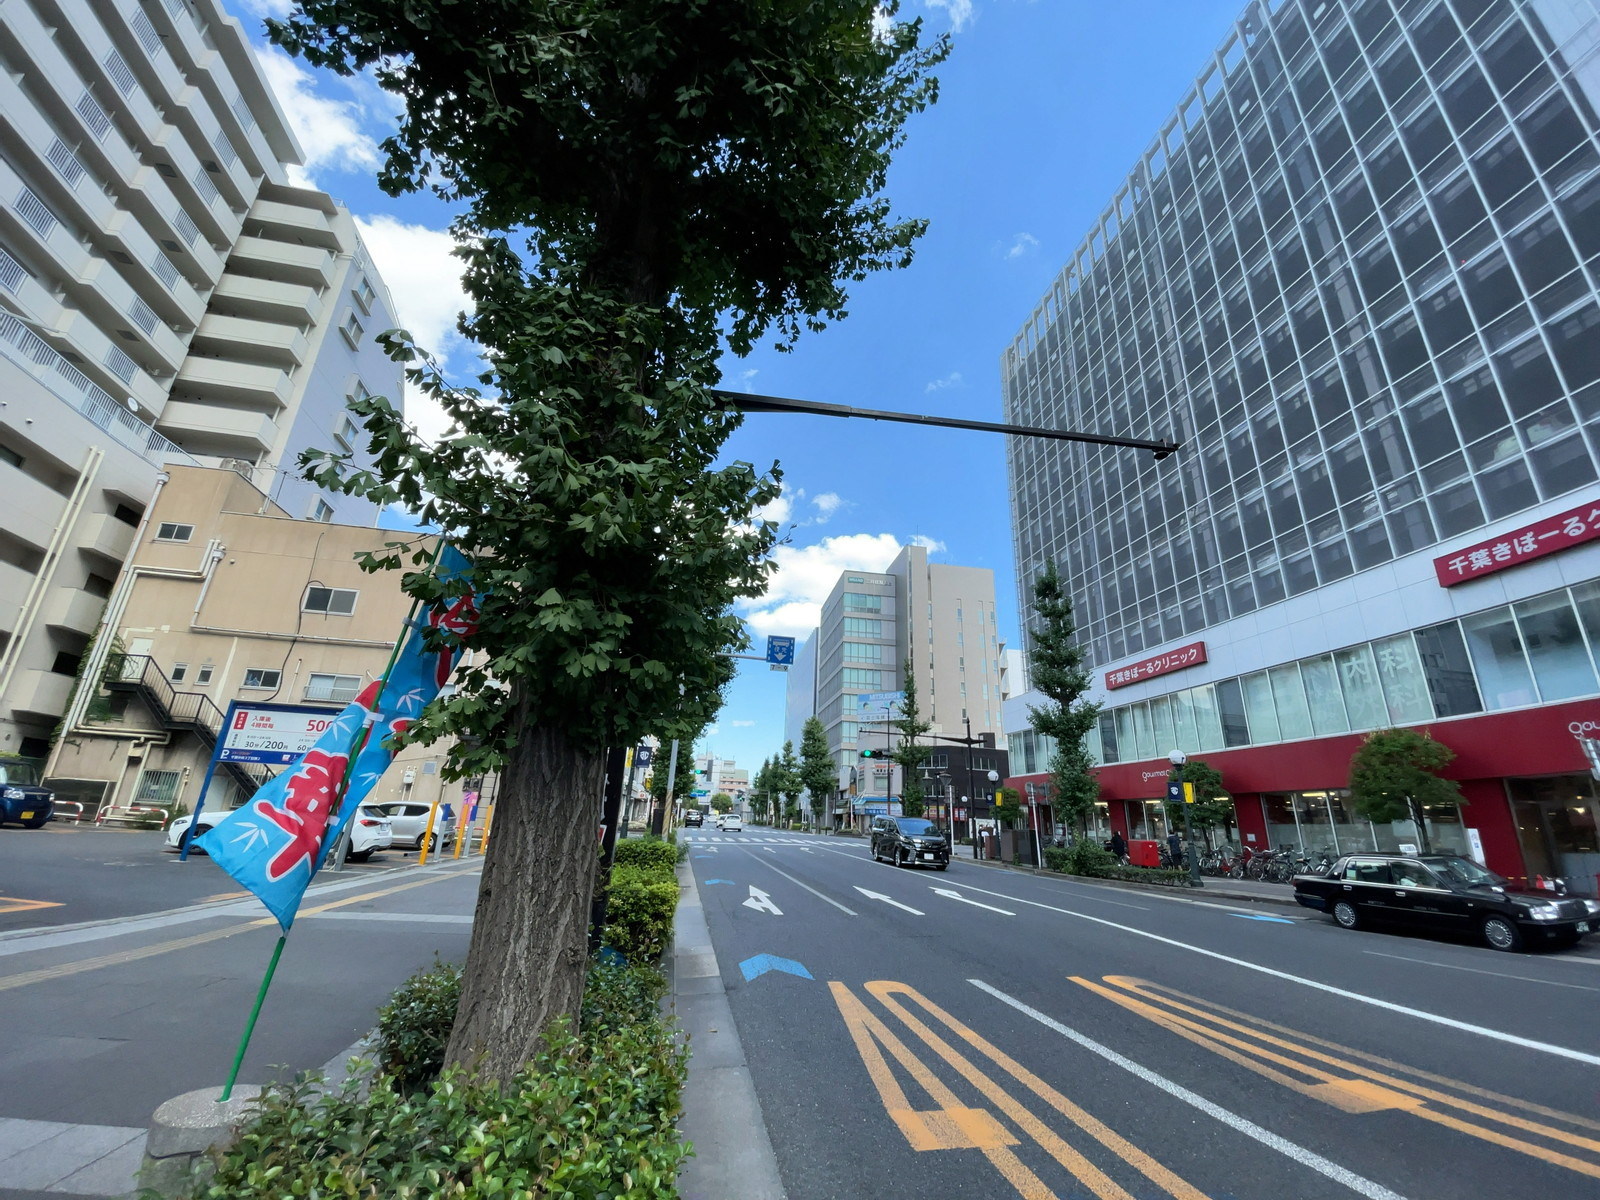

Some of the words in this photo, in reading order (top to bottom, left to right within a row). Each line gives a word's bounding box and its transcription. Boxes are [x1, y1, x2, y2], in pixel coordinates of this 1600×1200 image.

[1109, 648, 1197, 685] 千葉きぼーるクリニック
